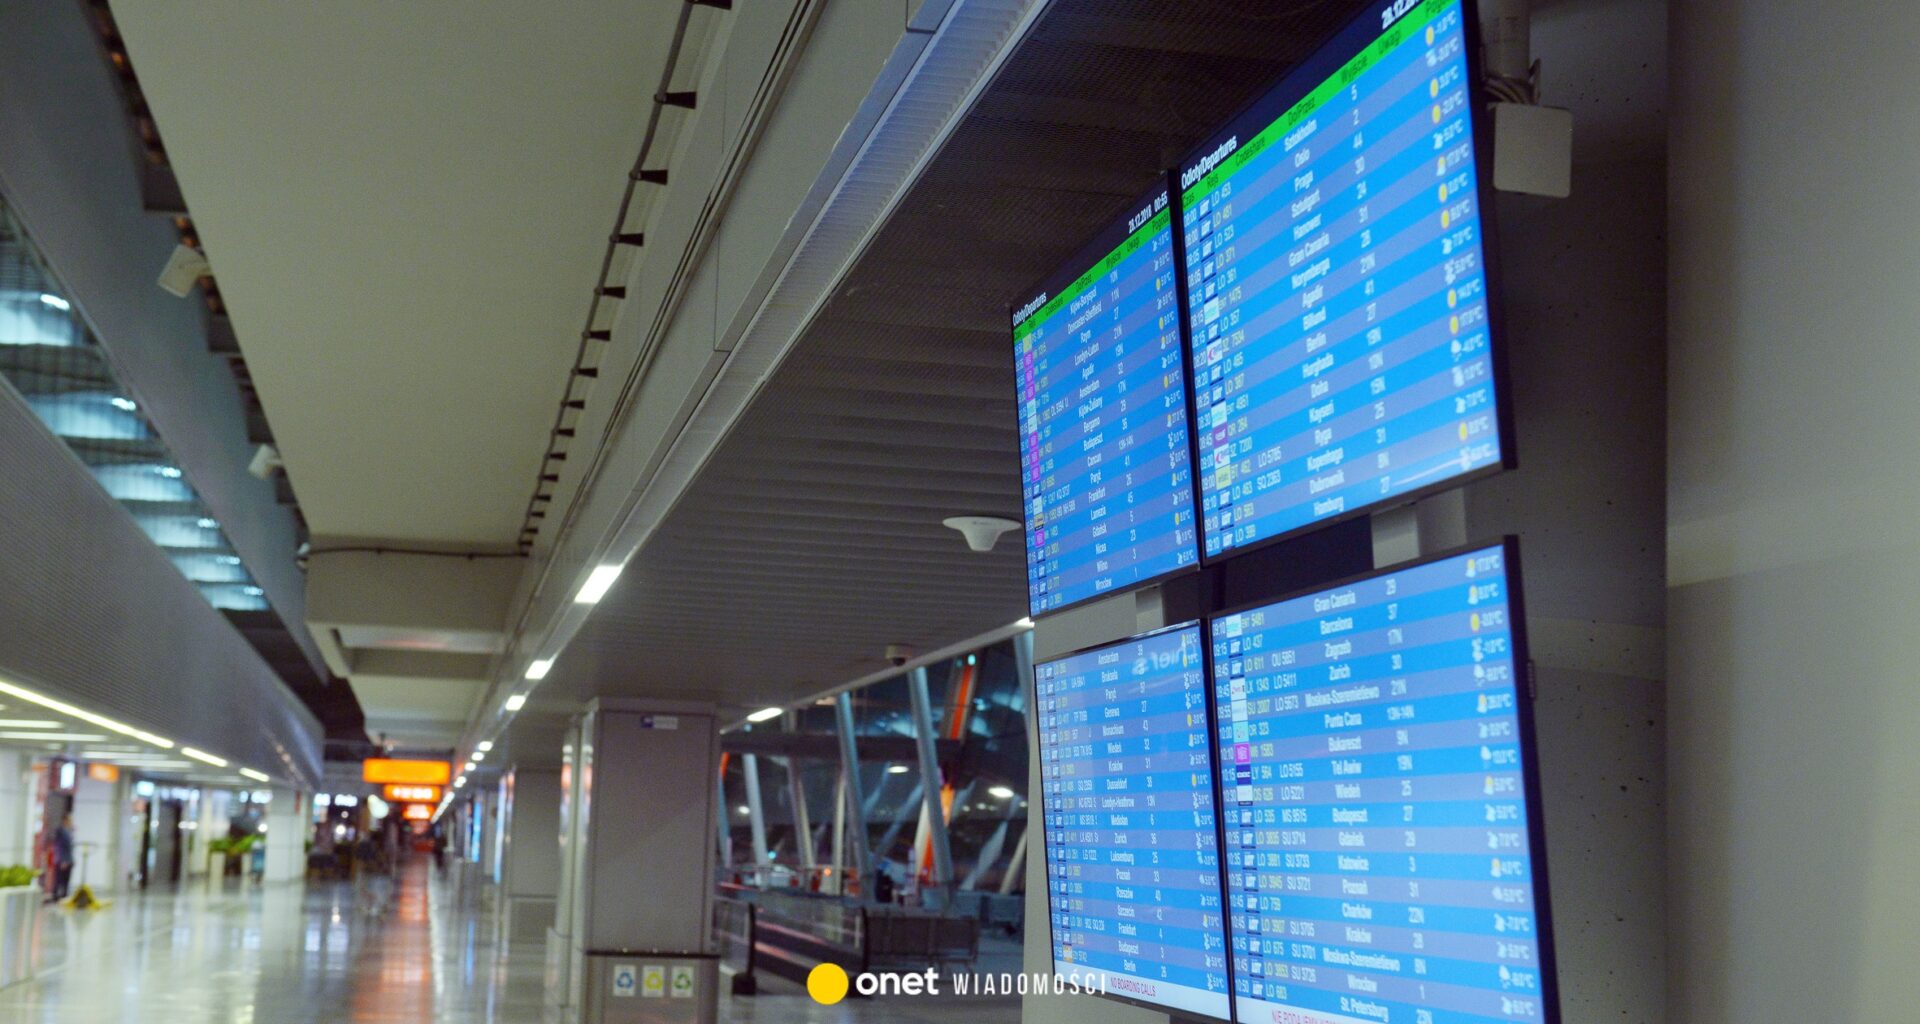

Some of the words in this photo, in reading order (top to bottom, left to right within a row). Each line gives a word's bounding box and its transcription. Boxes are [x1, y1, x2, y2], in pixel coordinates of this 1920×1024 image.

[1351, 84, 1357, 100] 5
[1294, 149, 1310, 167] Oslo
[1353, 109, 1359, 125] 2
[1294, 171, 1313, 191] Praga
[1353, 133, 1362, 148] 44
[1409, 856, 1416, 871] 3
[1117, 978, 1140, 993] BOARDING
[1140, 983, 1155, 997] CALLS
